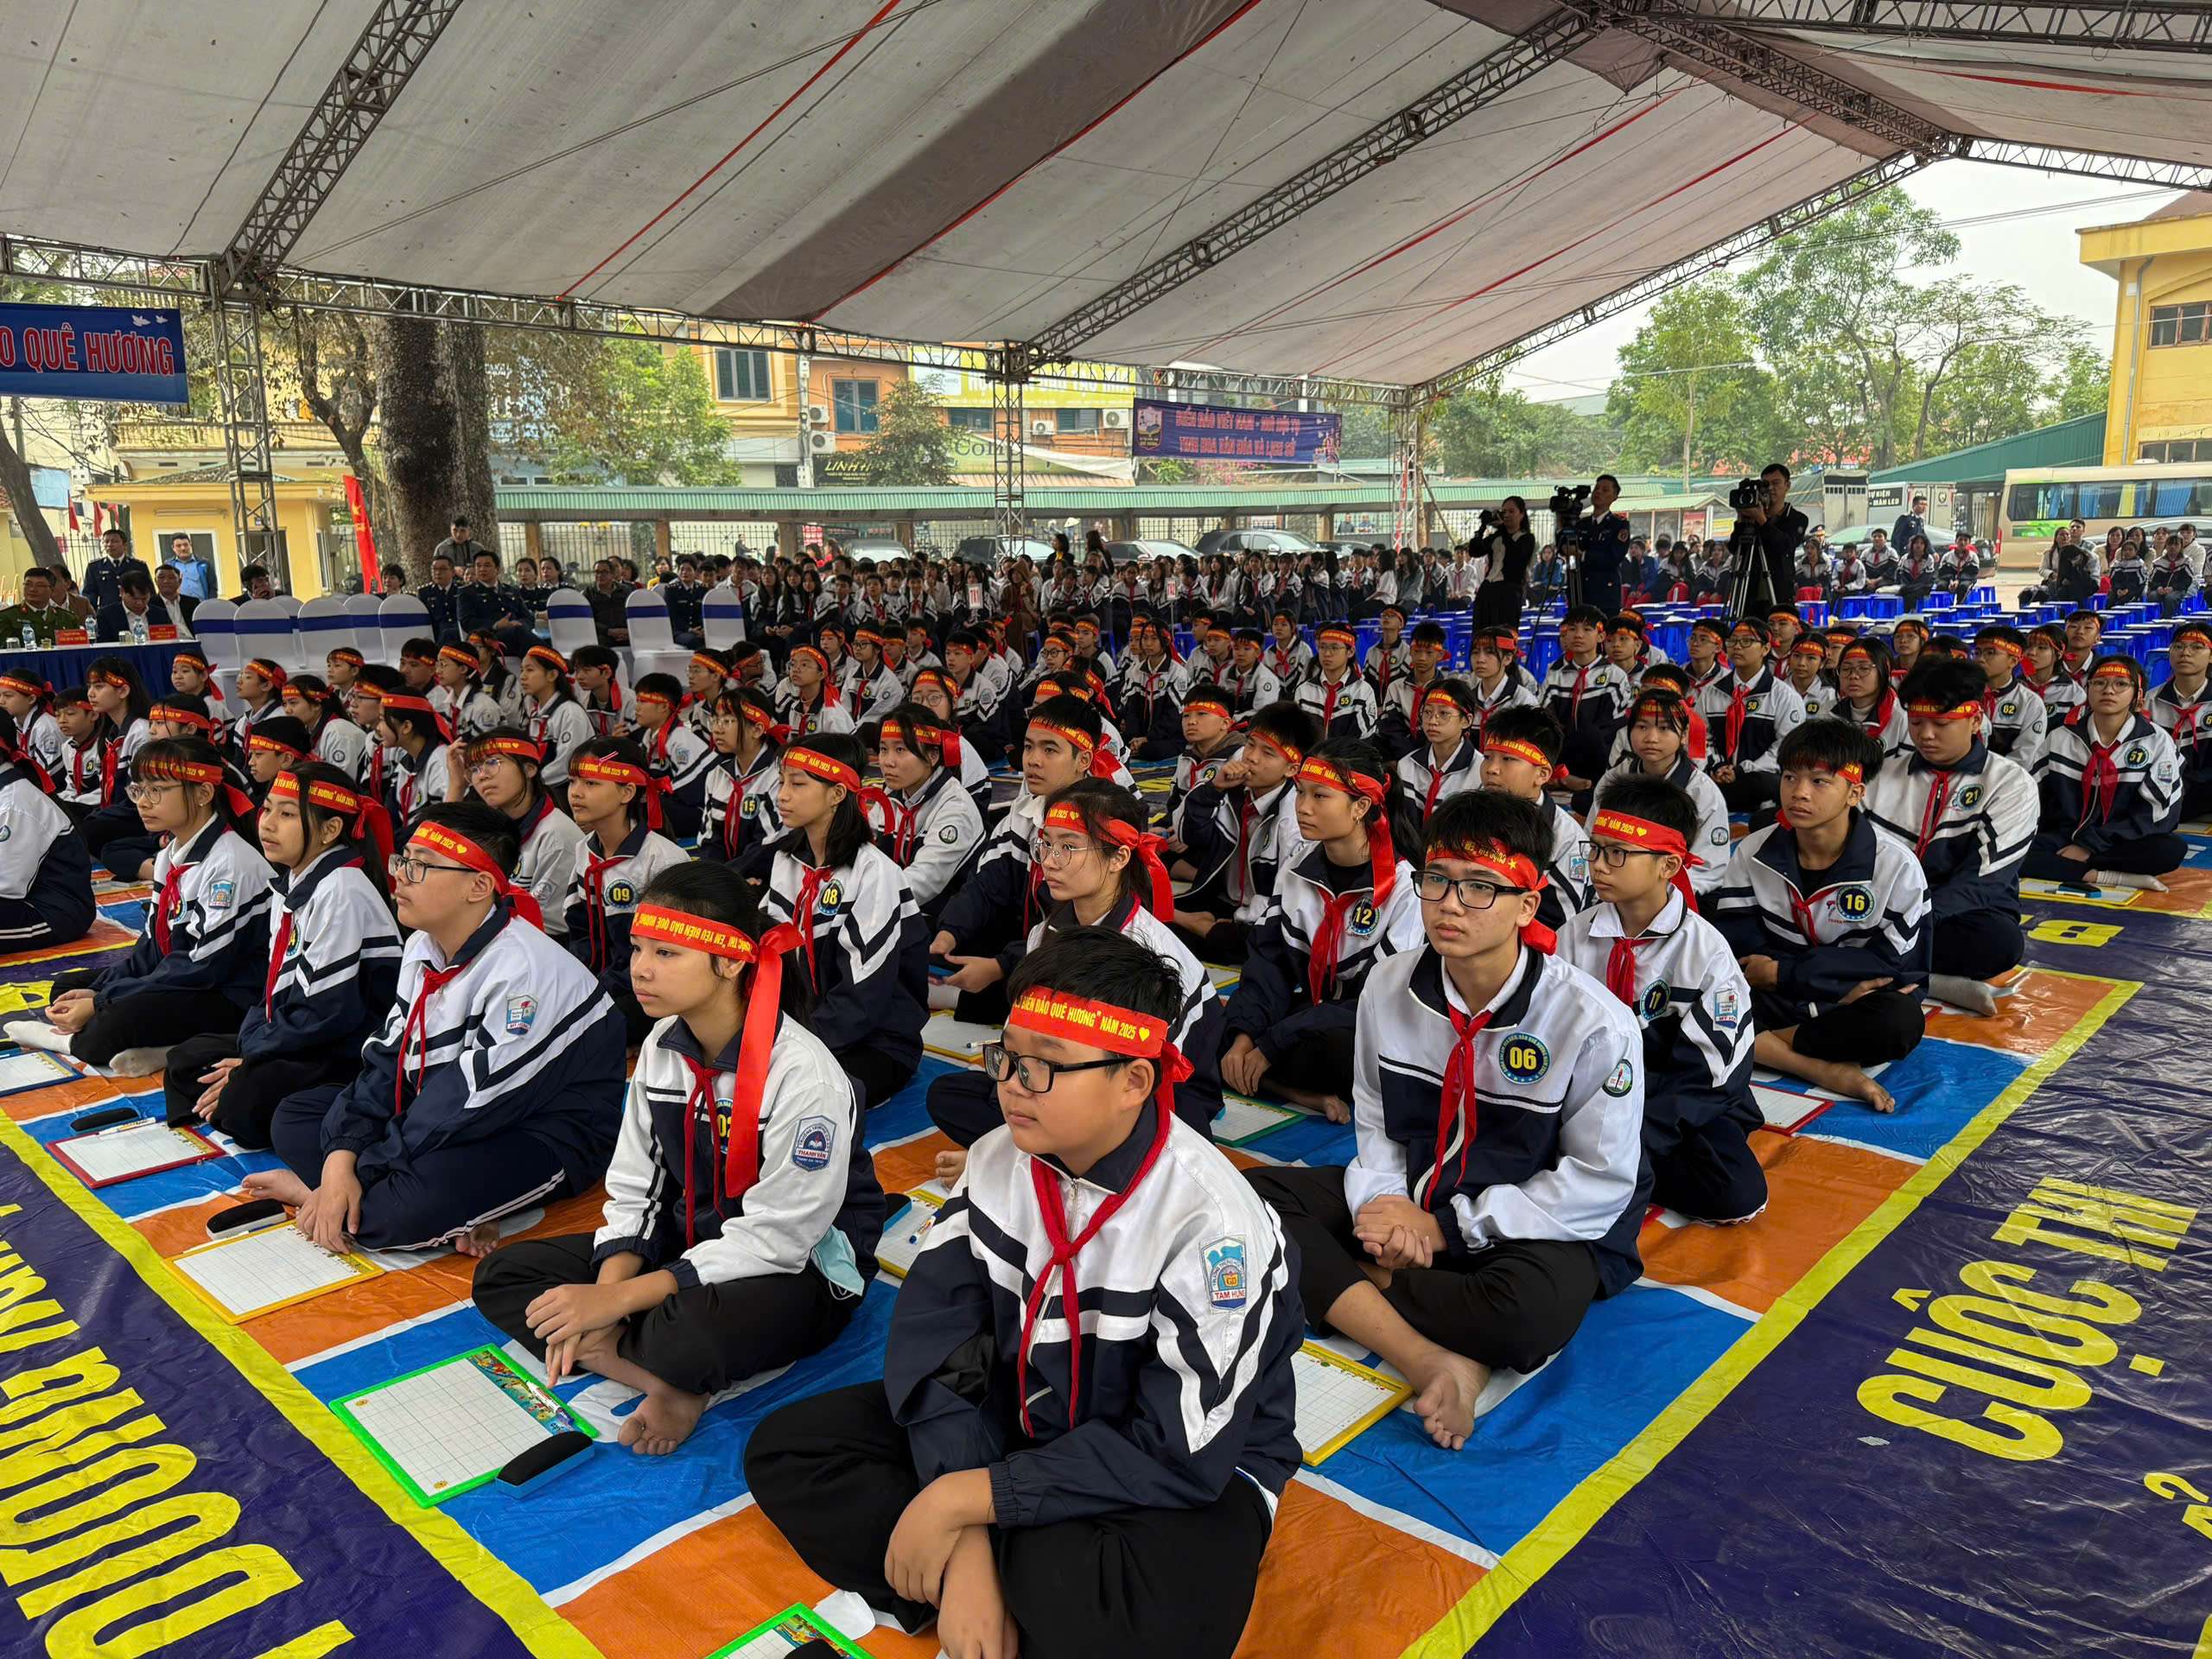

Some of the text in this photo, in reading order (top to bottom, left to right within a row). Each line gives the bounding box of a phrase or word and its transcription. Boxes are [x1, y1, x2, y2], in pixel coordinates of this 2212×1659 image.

[23, 322, 79, 373] QUÊ
[84, 330, 175, 377] HƯƠNG
[2003, 705, 2015, 714] 62
[2130, 751, 2142, 761] 51
[808, 757, 821, 768] NĂM
[819, 761, 831, 772] 2025
[335, 792, 346, 804] NĂM
[345, 797, 354, 806] 2025
[1965, 791, 1978, 804] 21
[744, 800, 755, 812] 15
[1608, 818, 1622, 830] NĂM
[1620, 823, 1635, 835] 2025
[428, 831, 443, 843] NĂM
[440, 836, 456, 850] 2025
[613, 889, 629, 901] 09
[822, 887, 837, 904] 08
[1846, 894, 1865, 911] 16
[655, 917, 670, 930] QUÊ
[1354, 908, 1371, 924] 12
[670, 921, 684, 937] ĐẢO
[684, 924, 699, 940] BIỂN
[700, 928, 714, 944] YÊU
[1649, 991, 1662, 1009] 11
[1021, 992, 1034, 1011] BIỂN
[1035, 995, 1050, 1014] ĐẢO
[1050, 1002, 1067, 1019] QUÊ
[1100, 1015, 1119, 1034] NĂM
[1119, 1022, 1137, 1040] 2025
[1510, 1046, 1537, 1070] 06
[1857, 1176, 2200, 1460] CUỘC THI
